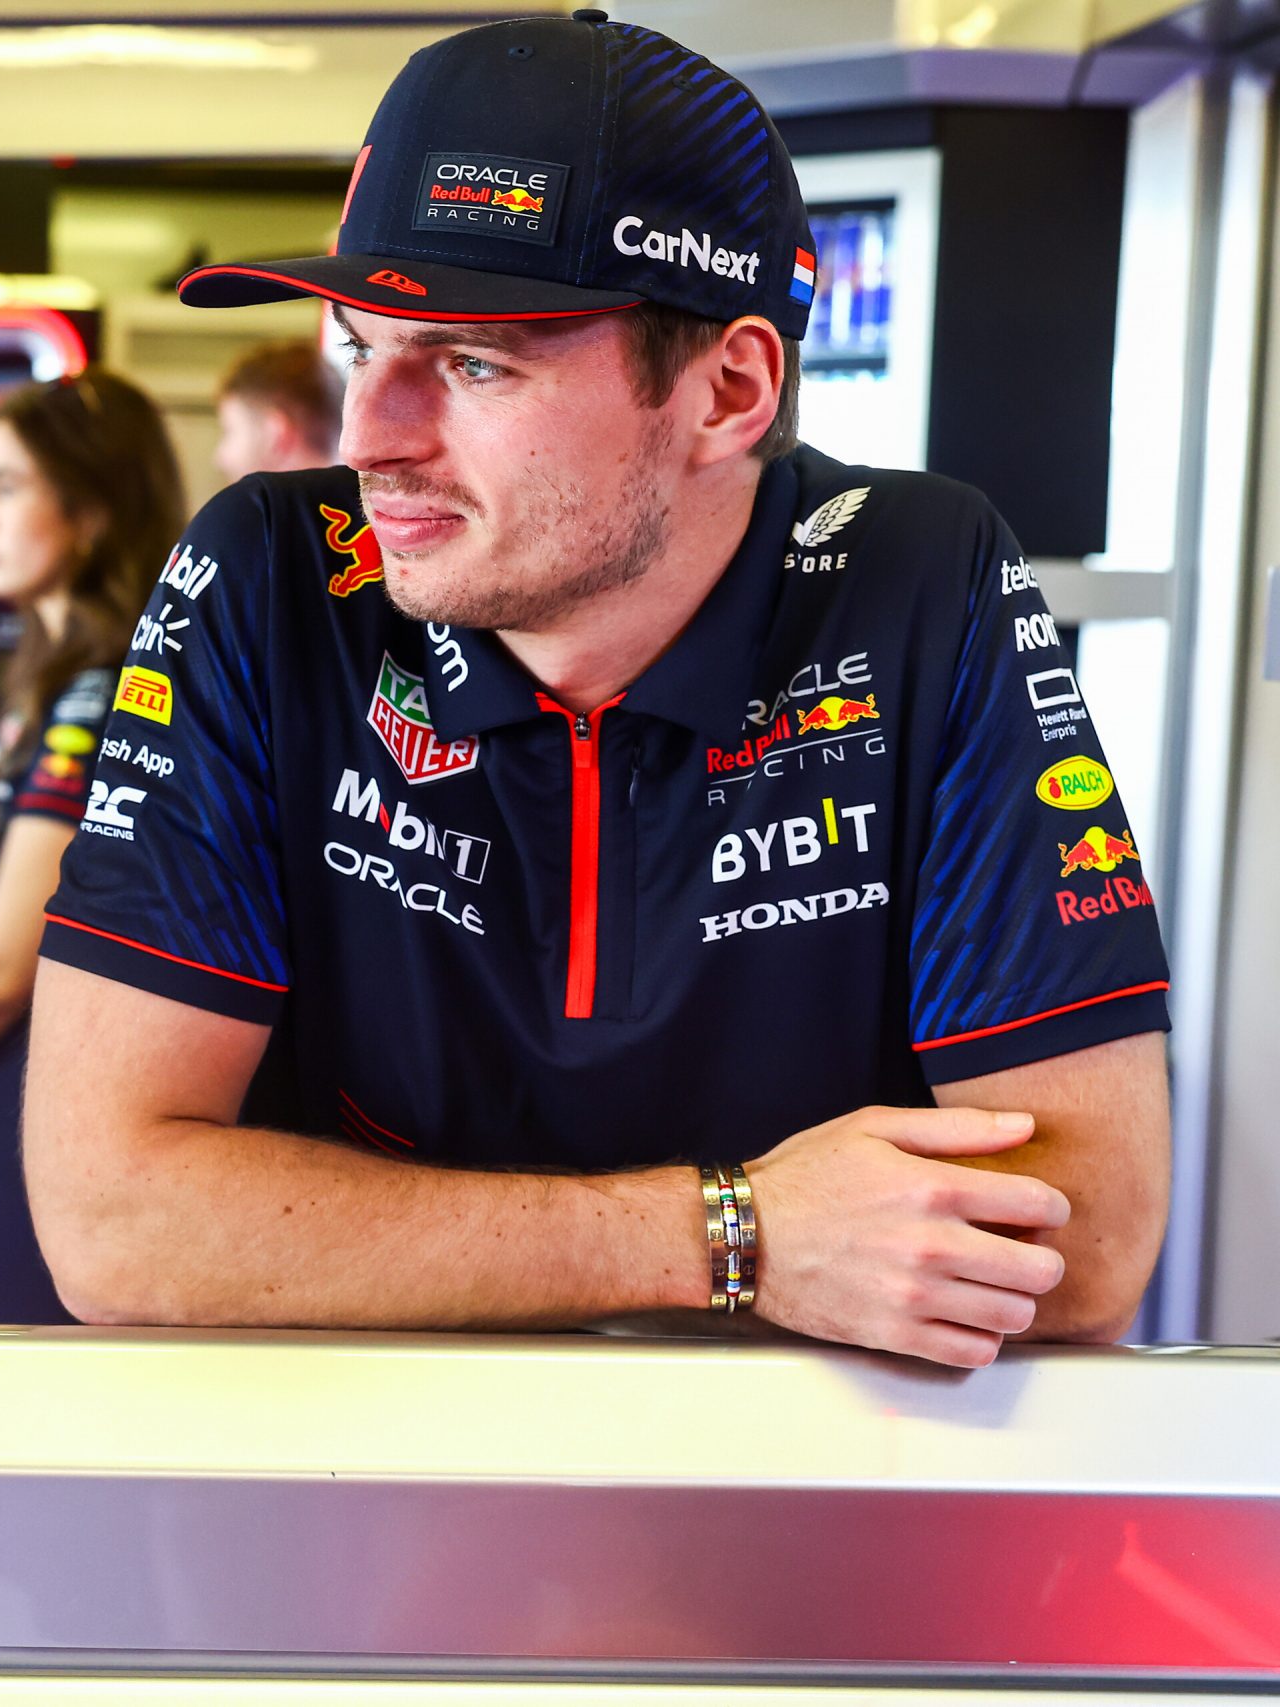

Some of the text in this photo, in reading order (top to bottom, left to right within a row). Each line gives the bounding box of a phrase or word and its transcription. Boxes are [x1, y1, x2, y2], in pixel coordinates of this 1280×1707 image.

[430, 184, 490, 204] Red Bull
[436, 163, 549, 191] ORACLE
[427, 208, 540, 231] RACING
[613, 215, 761, 285] CarNext
[159, 542, 218, 600] bil
[387, 664, 431, 719] TA
[741, 652, 873, 731] RACLE
[132, 745, 175, 778] App
[376, 701, 468, 775] HEUER
[706, 740, 755, 774] Red
[707, 736, 886, 806] RCING
[711, 797, 877, 884] BYBIT
[323, 841, 485, 936] ORACLE
[699, 881, 890, 943] HONDA
[1055, 877, 1120, 926] Red
